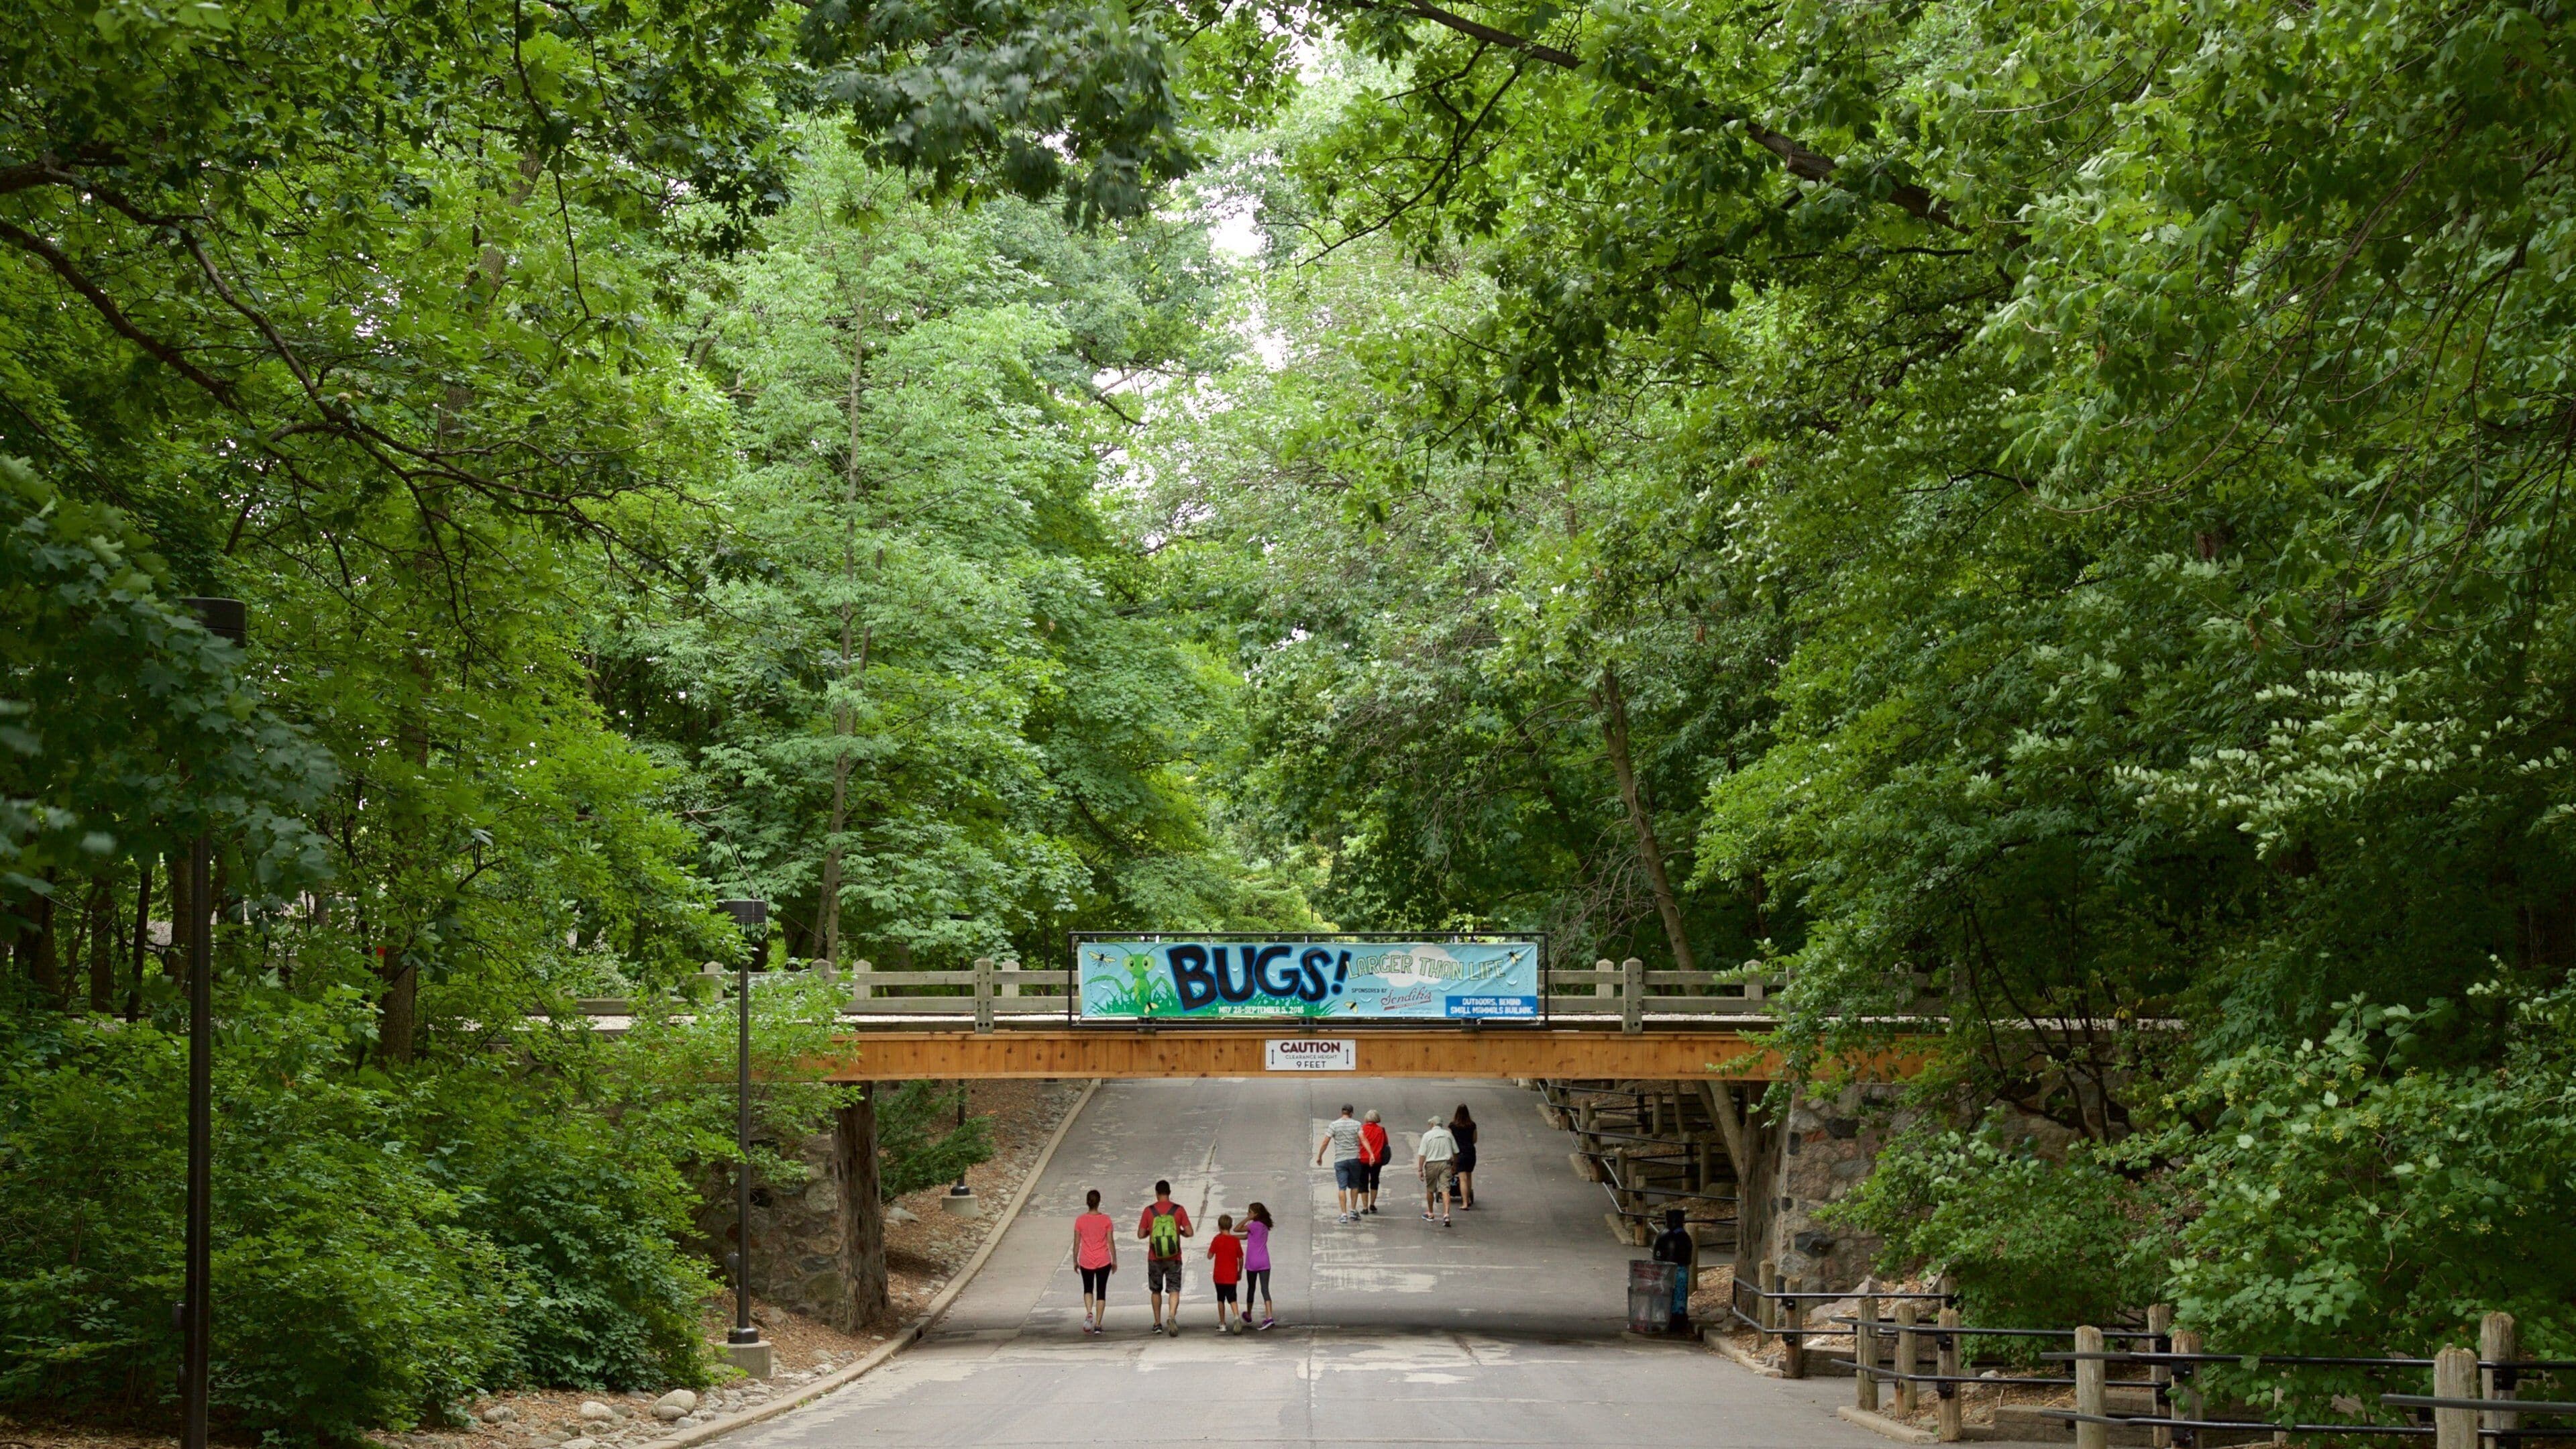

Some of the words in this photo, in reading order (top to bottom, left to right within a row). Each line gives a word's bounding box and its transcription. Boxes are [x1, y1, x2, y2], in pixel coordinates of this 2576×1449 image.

[1346, 955, 1413, 979] LARGER
[1419, 957, 1465, 981] THAN
[1468, 959, 1507, 981] LIFE
[1166, 943, 1352, 1012] BUGS!
[1289, 1006, 1303, 1014] 2016
[1450, 1006, 1471, 1014] SMALL
[1472, 1006, 1503, 1014] MAMMALS
[1504, 1006, 1534, 1014] BUILDING
[1280, 1042, 1340, 1053] CAUTION
